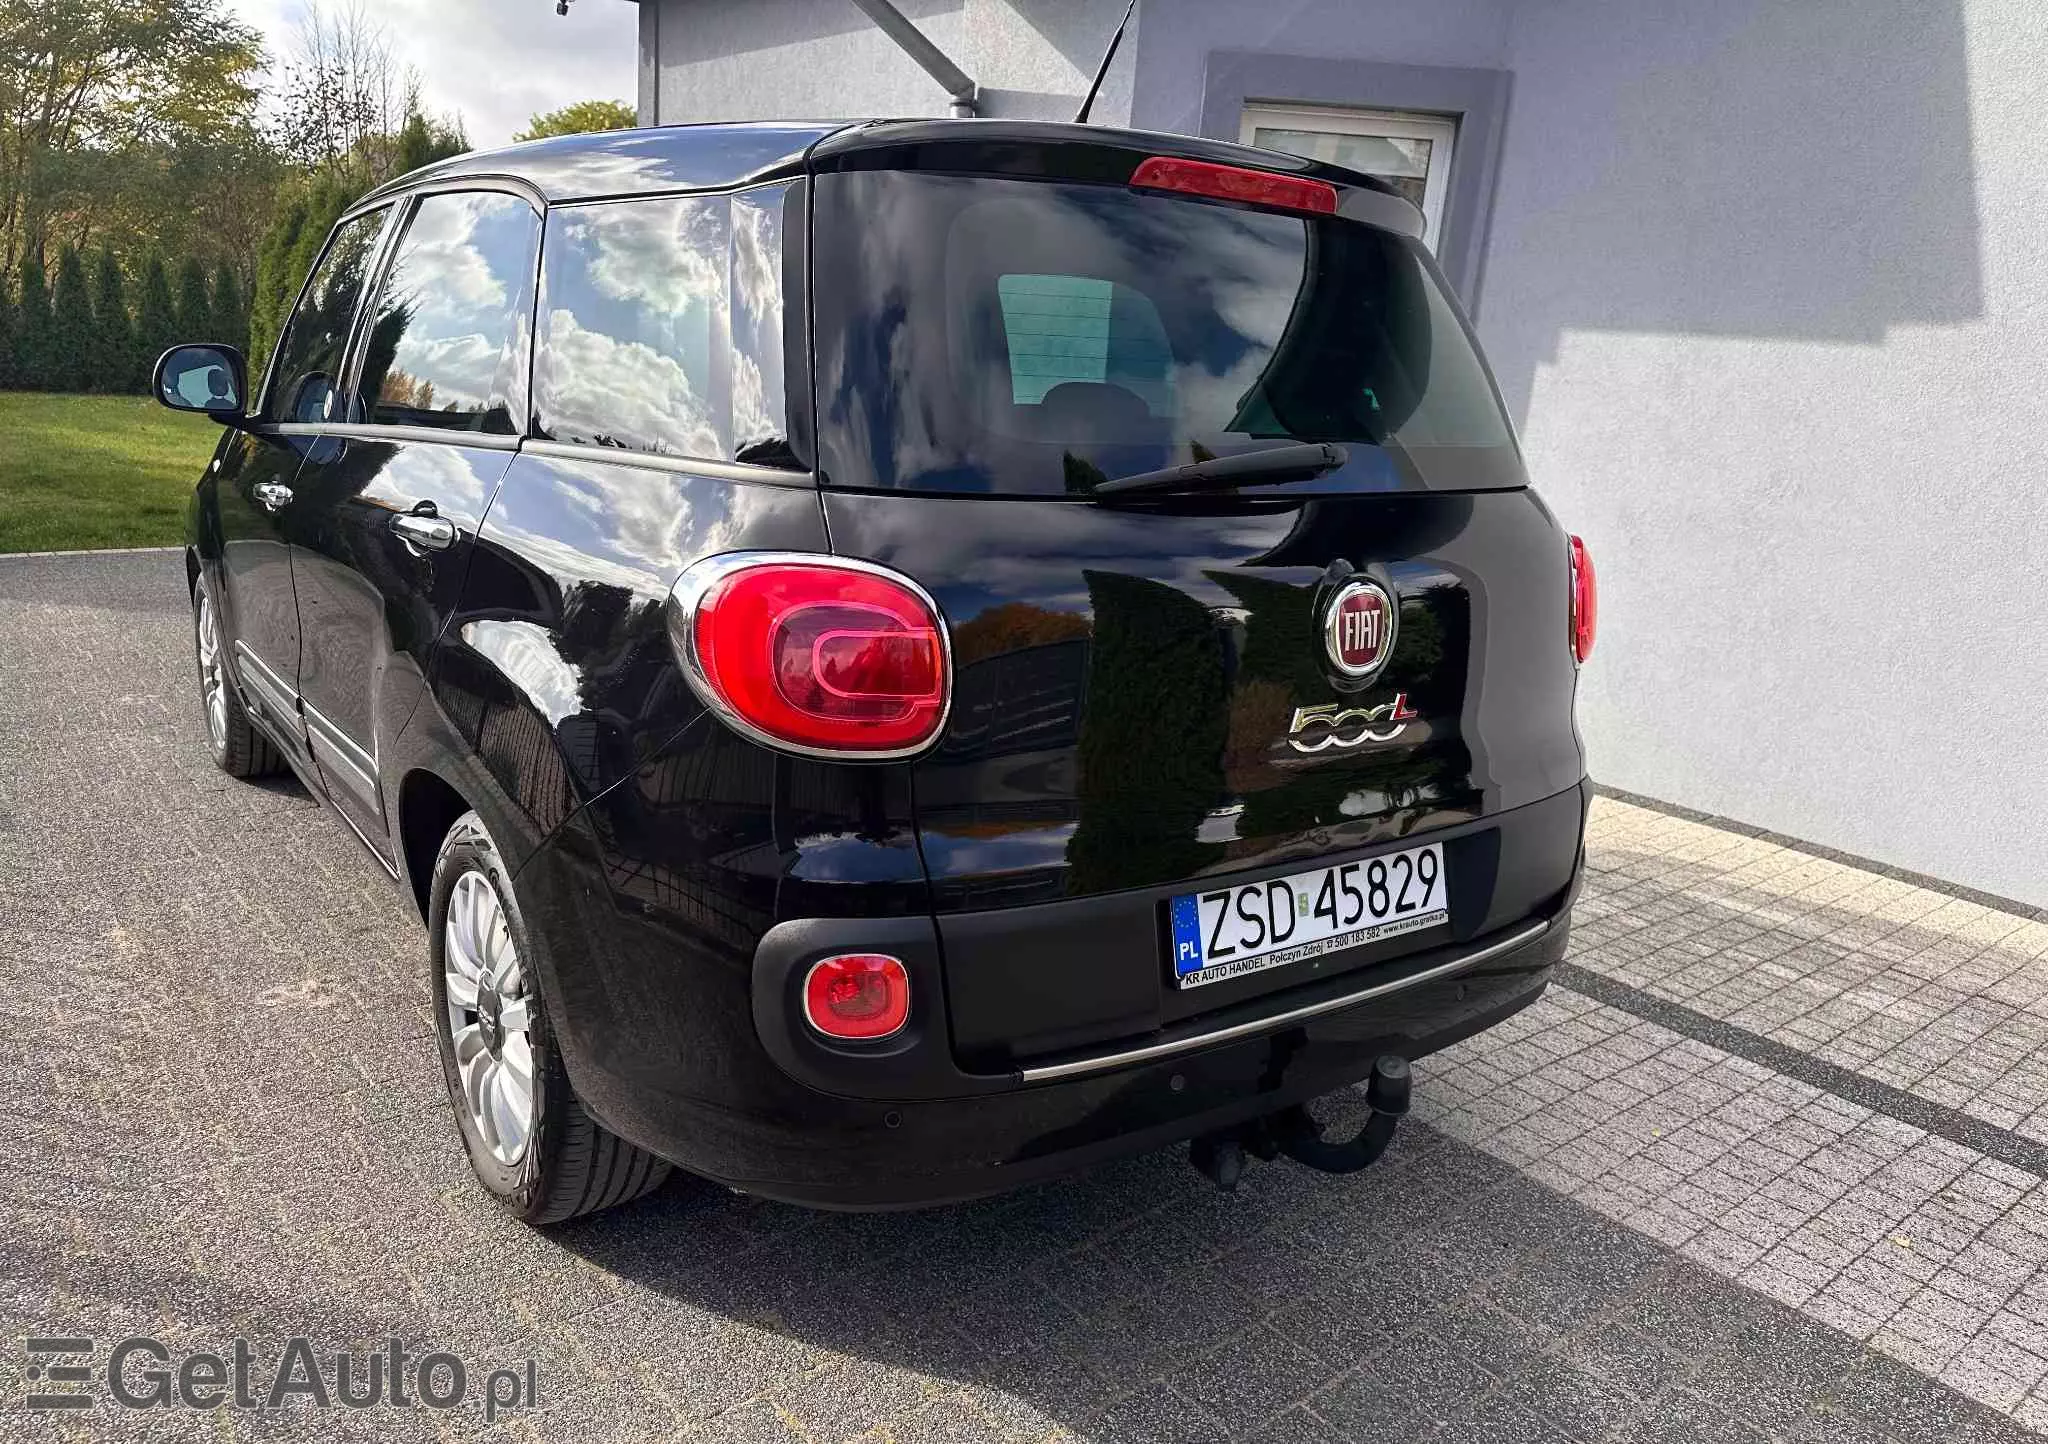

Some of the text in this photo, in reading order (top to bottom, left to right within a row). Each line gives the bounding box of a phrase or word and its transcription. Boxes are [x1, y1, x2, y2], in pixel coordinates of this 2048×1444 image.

[1344, 610, 1380, 651] FIAT
[1202, 849, 1438, 959] ZSD 45829
[1179, 943, 1199, 960] PL
[1186, 973, 1200, 985] KR
[1201, 967, 1227, 981] AUTO
[1229, 958, 1265, 974] HANDEL
[1335, 934, 1349, 947] 500
[1351, 930, 1365, 943] 183
